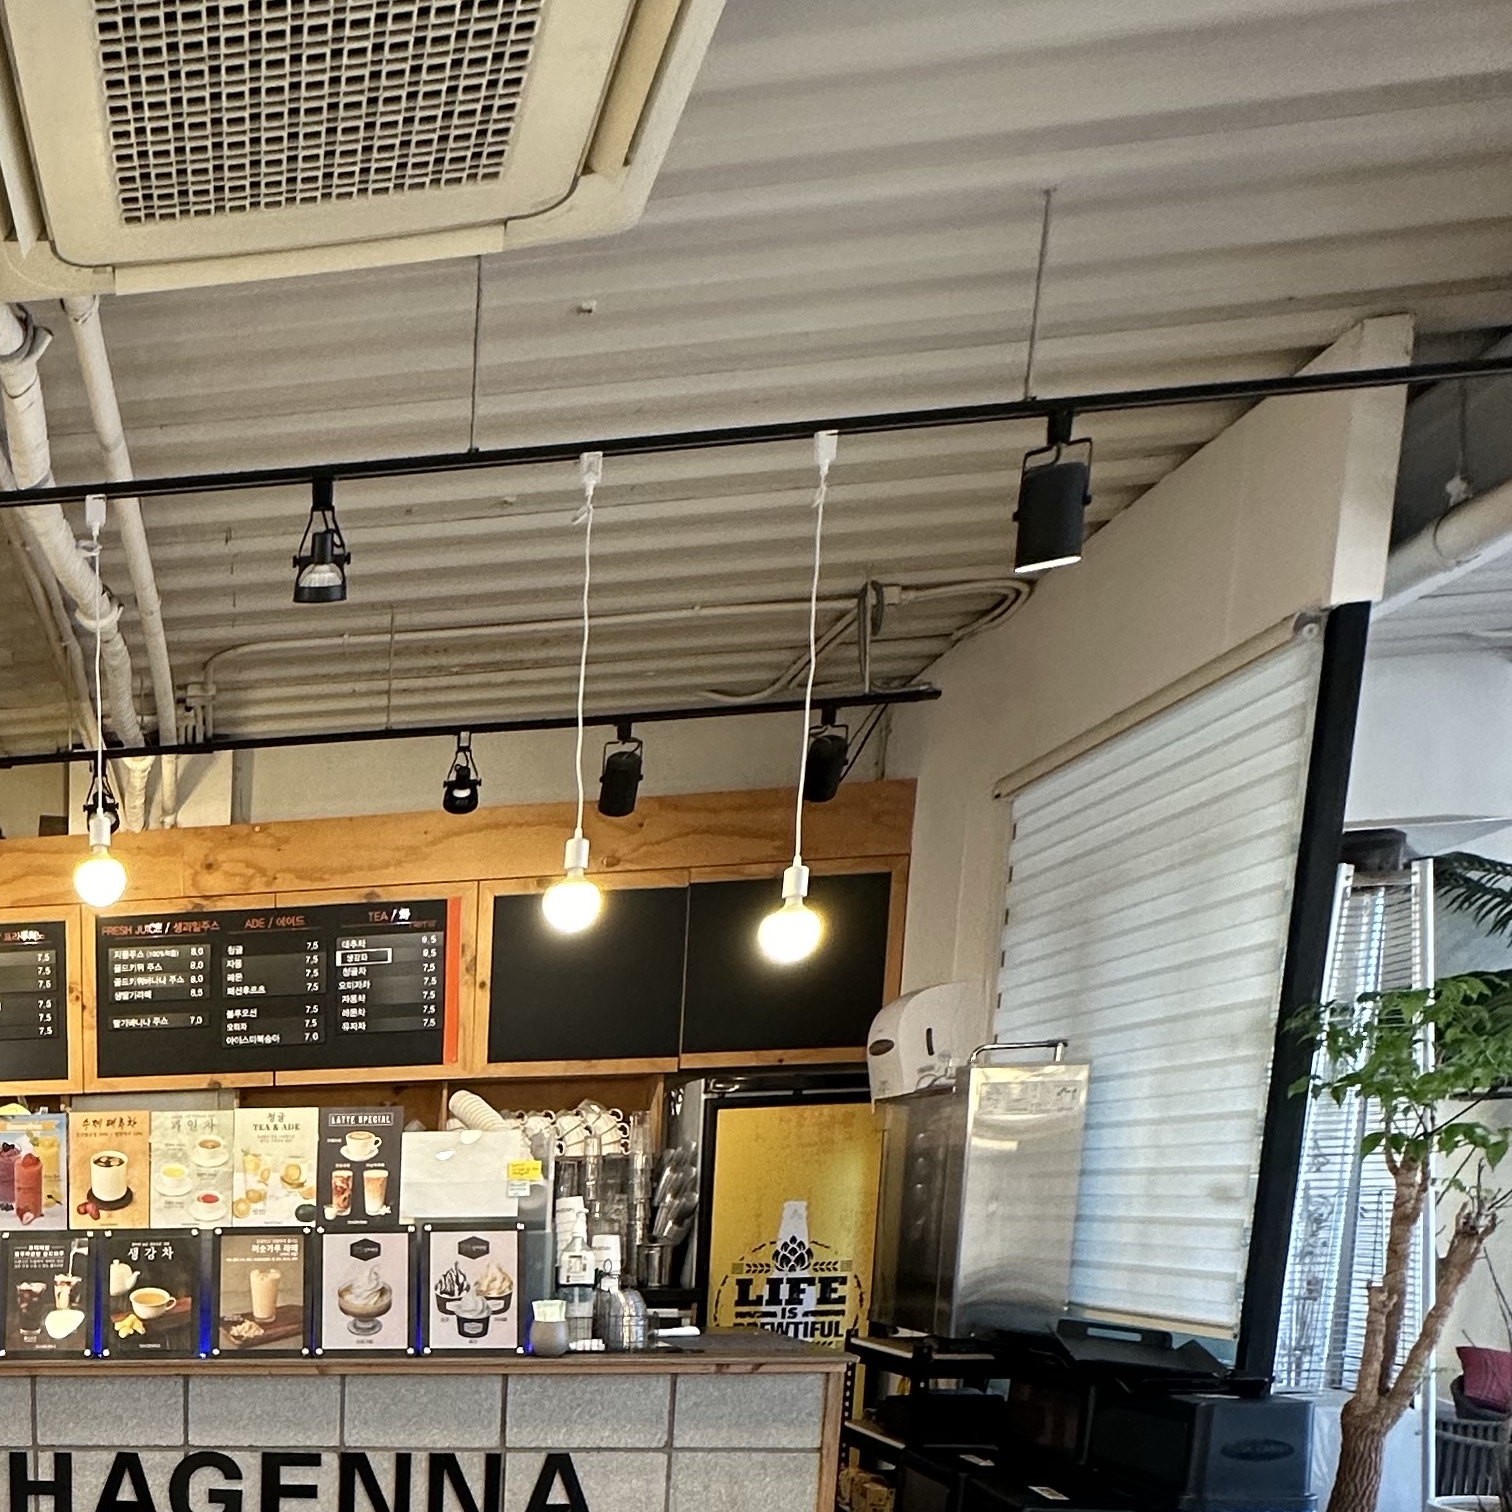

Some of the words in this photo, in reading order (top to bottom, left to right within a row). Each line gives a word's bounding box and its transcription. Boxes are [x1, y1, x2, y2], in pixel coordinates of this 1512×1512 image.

[368, 911, 388, 921] TEA
[244, 918, 265, 929] ADE
[102, 926, 132, 936] FRESH
[422, 963, 435, 972] 7.5
[331, 1115, 355, 1124] LATTE
[358, 1115, 391, 1124] SPECIAL
[253, 1123, 270, 1131] TEA
[282, 1123, 301, 1131] ADE
[128, 1246, 174, 1261] 생강차
[252, 1244, 281, 1253] 미숫가루
[734, 1276, 848, 1307] LIFE
[781, 1307, 798, 1320] IS
